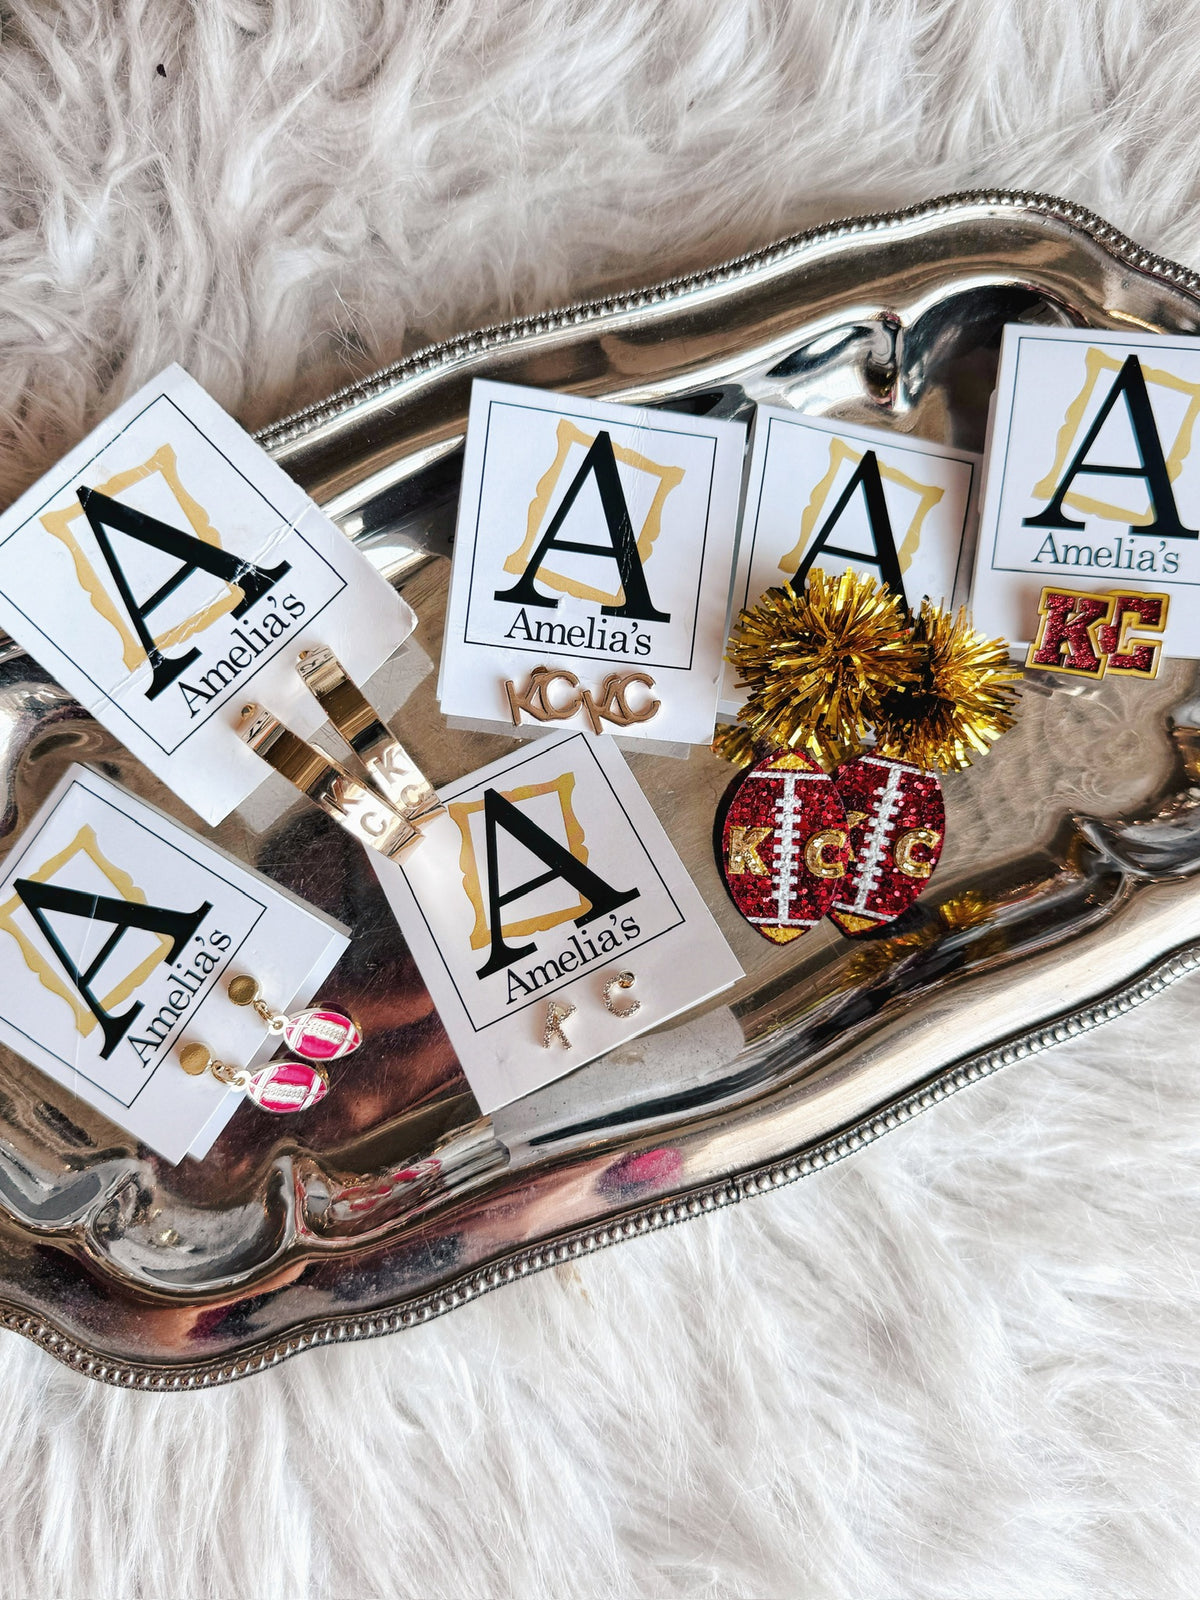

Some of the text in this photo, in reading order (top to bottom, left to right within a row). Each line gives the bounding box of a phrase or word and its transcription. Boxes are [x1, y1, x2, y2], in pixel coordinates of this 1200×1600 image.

[1021, 354, 1199, 540] A
[76, 485, 292, 701] A
[494, 430, 671, 623] A
[768, 450, 913, 612] A
[1031, 532, 1180, 574] Amelia's
[175, 591, 306, 719] Amelia's
[504, 607, 652, 656] Amelia's
[1025, 586, 1170, 680] KC
[475, 788, 641, 980] A
[13, 878, 214, 1060] A
[126, 929, 232, 1068] Amelia's
[506, 914, 640, 1005] Amelia's
